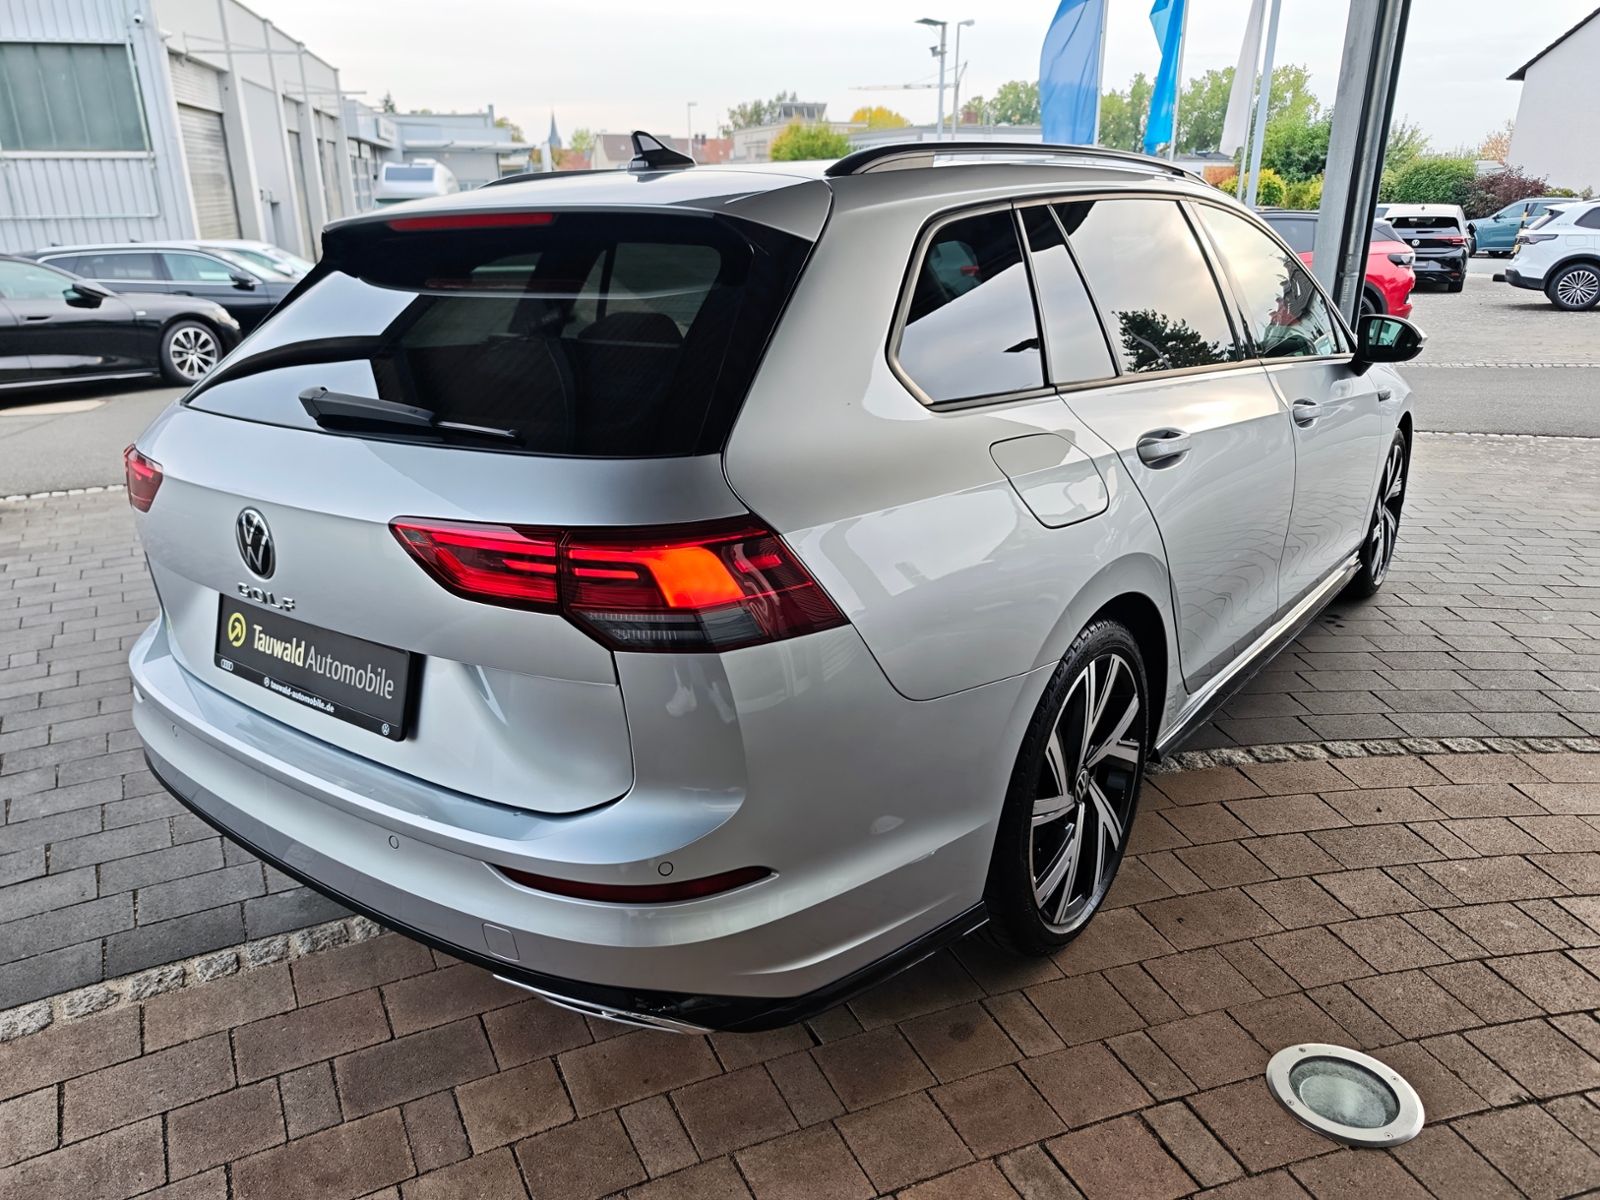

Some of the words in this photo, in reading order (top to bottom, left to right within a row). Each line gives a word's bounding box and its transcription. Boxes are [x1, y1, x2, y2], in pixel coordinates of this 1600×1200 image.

[238, 582, 296, 611] GOLF
[252, 624, 306, 667] Tauwald
[305, 645, 395, 700] Automobile
[270, 680, 335, 713] tauwald-automobile.de
